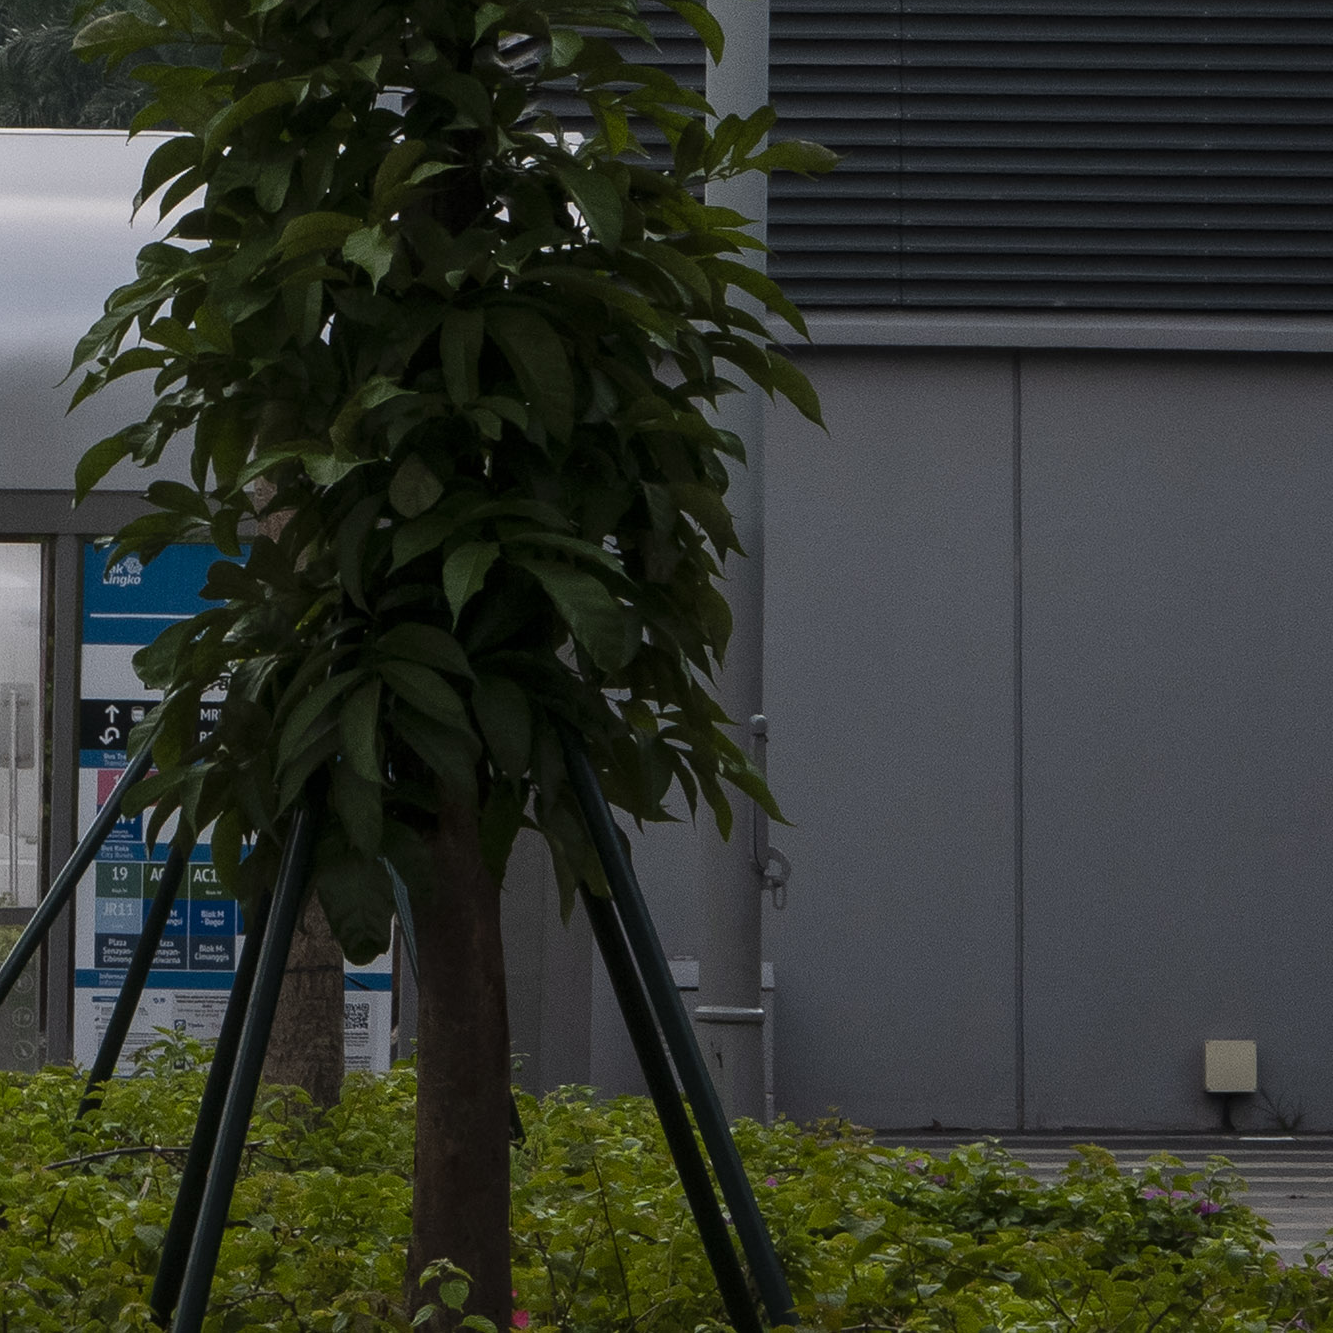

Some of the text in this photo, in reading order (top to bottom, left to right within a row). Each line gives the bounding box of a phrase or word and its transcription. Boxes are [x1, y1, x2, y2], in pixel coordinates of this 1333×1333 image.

[103, 574, 142, 587] Lingko
[200, 708, 222, 721] MR
[112, 866, 128, 881] 19
[193, 868, 221, 883] AC1
